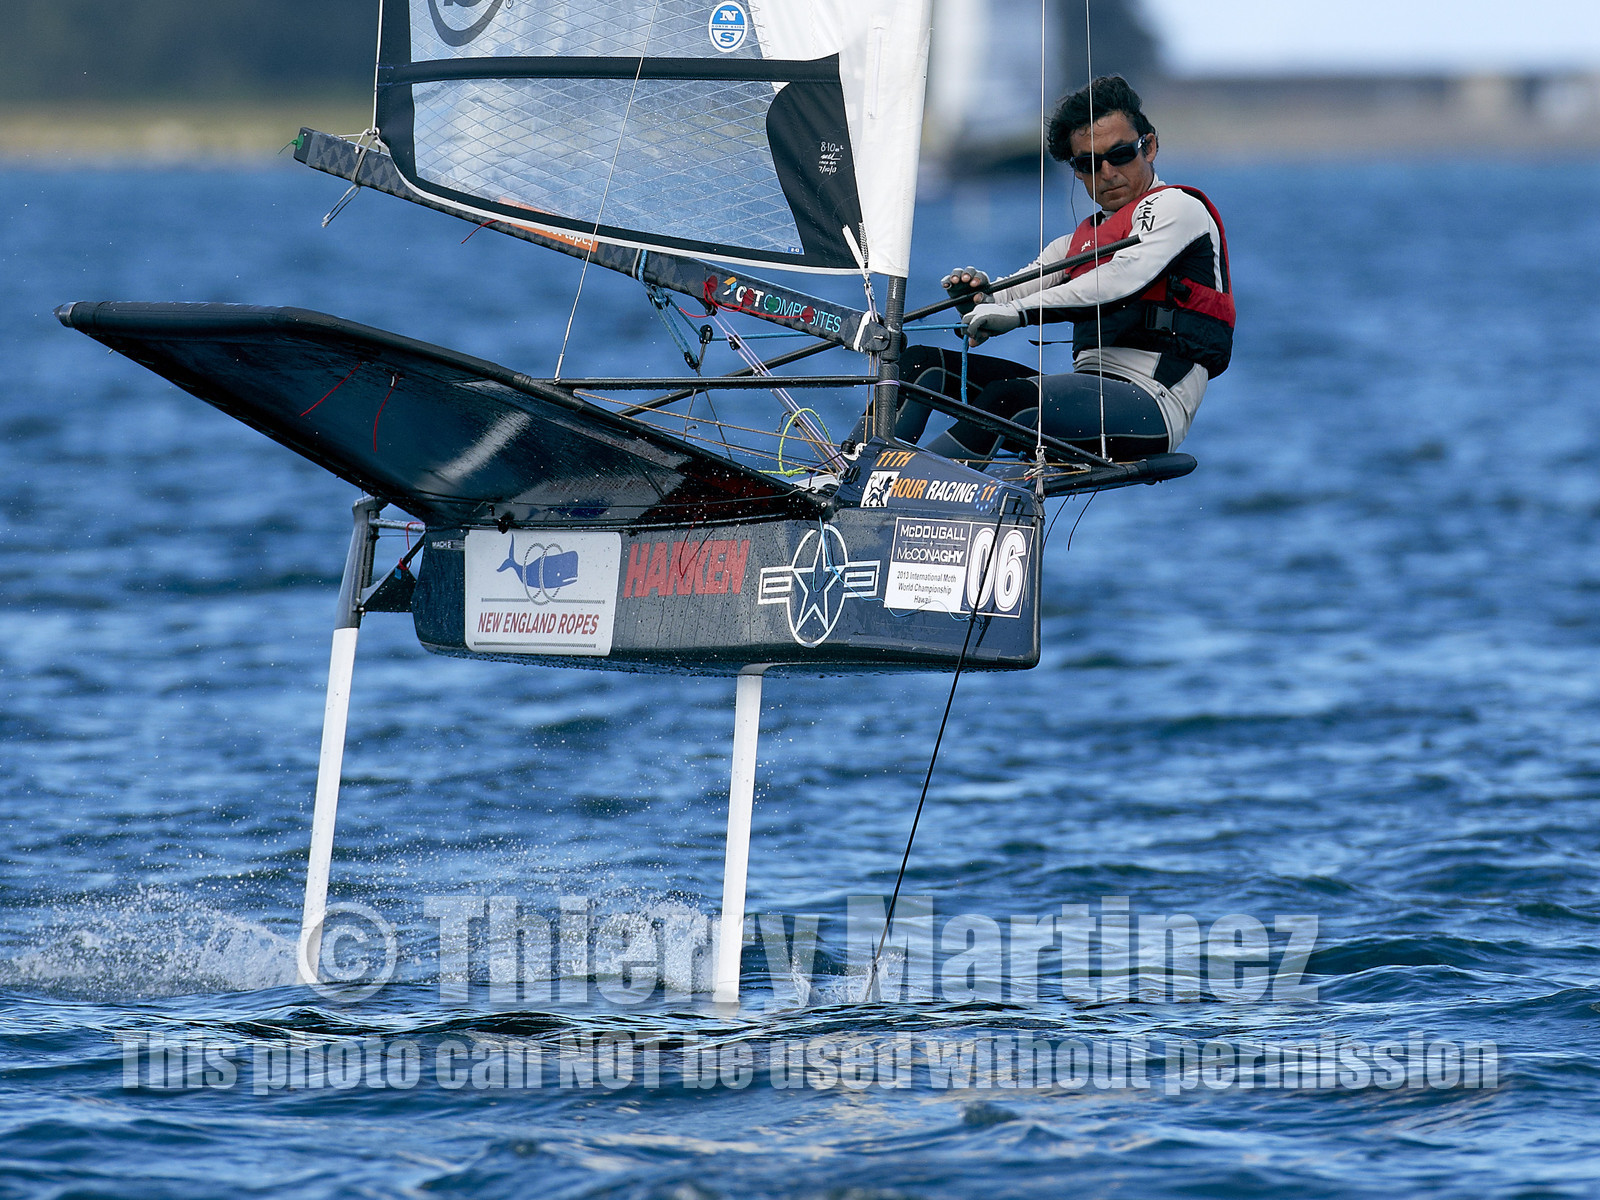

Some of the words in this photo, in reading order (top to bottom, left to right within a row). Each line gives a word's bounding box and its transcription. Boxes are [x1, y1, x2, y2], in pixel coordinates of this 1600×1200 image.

[720, 10, 739, 21] N
[720, 32, 735, 42] S
[735, 285, 764, 307] CT
[876, 450, 916, 467] 11TH
[889, 478, 928, 499] HOUR
[925, 480, 979, 503] RACING
[966, 527, 1027, 612] 06
[914, 583, 952, 595] Championship
[477, 612, 501, 633] NEW
[502, 612, 557, 634] ENGLAND
[557, 613, 600, 635] ROPES
